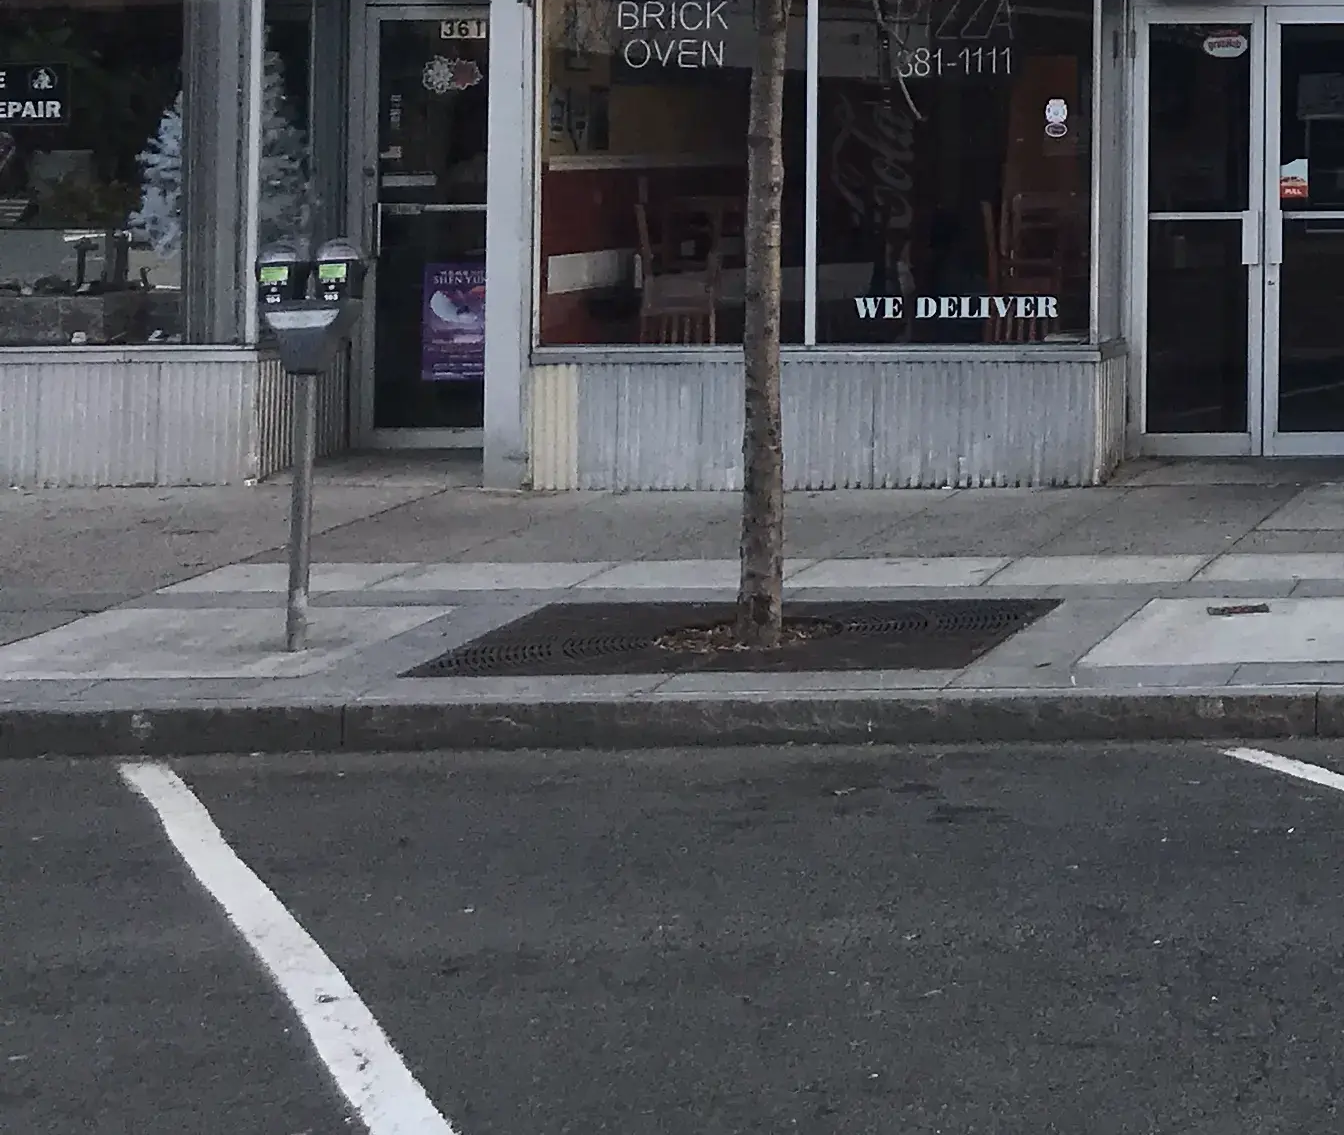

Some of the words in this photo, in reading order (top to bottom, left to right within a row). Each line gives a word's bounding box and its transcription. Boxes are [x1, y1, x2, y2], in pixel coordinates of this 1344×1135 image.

[617, 1, 728, 30] BRICK
[443, 21, 483, 37] 361
[623, 39, 725, 68] OVEN
[433, 275, 463, 285] SHEN
[854, 296, 902, 319] WE
[915, 296, 1059, 319] DELIVER
